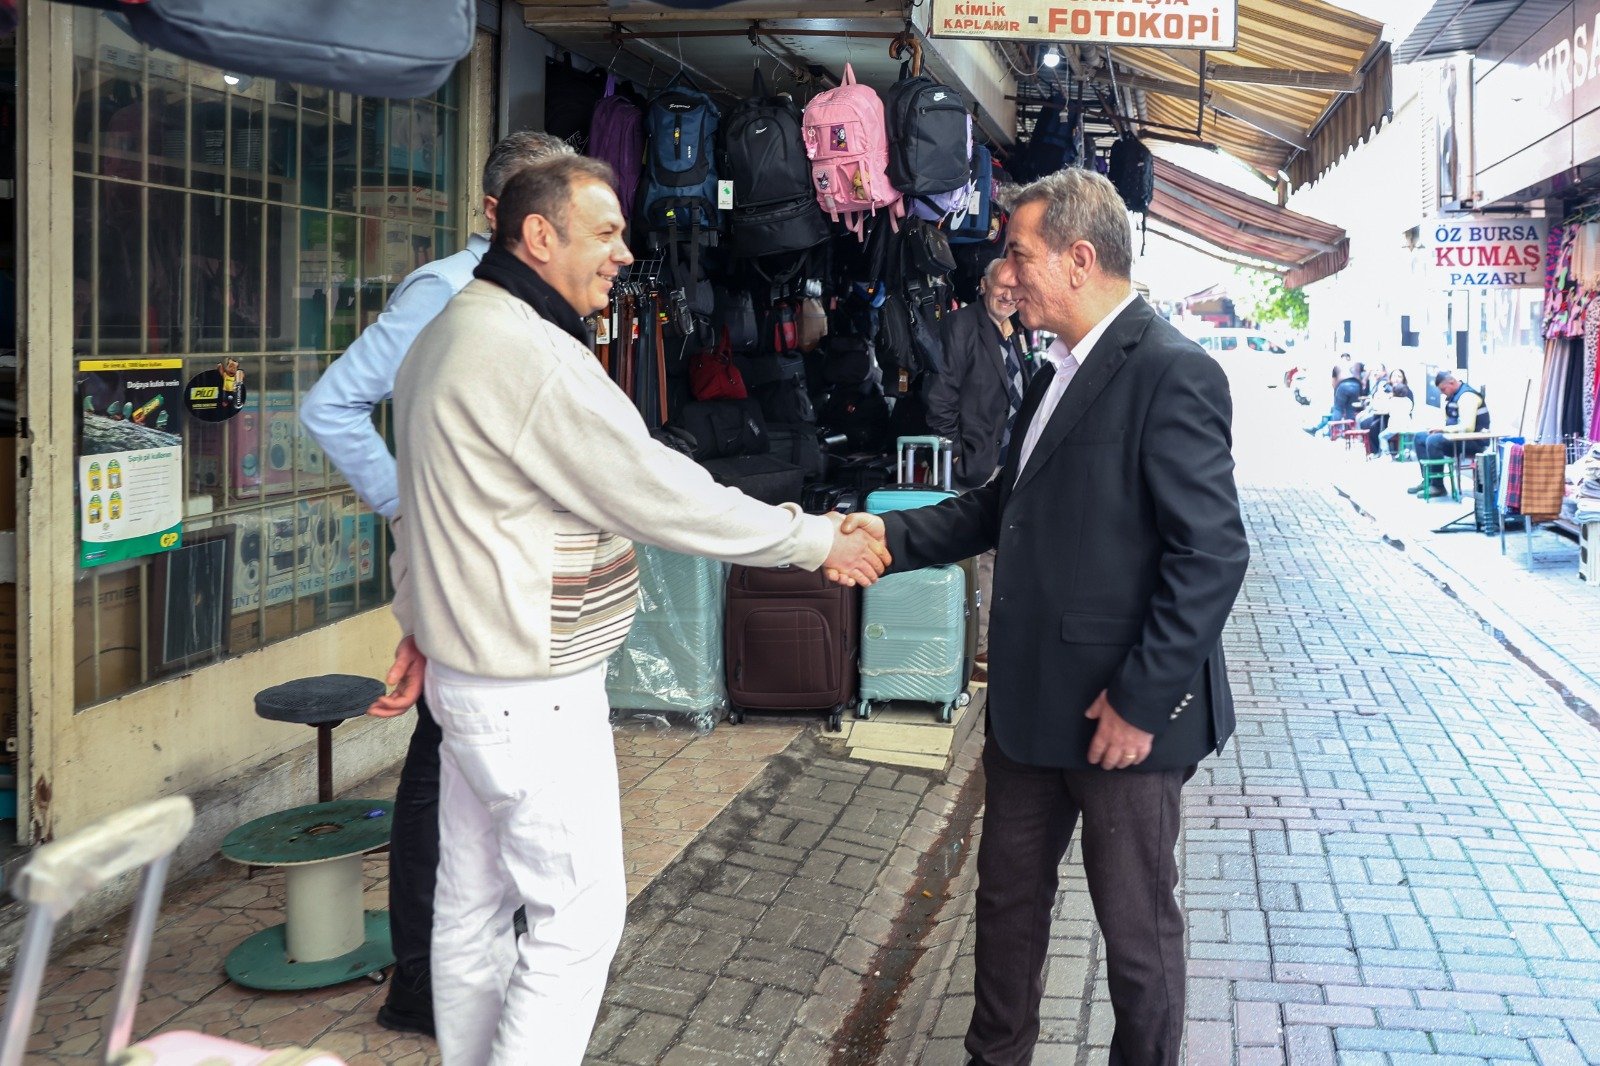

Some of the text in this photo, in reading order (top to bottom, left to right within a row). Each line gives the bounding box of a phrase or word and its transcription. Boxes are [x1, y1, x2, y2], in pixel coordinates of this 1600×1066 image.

[954, 1, 1006, 16] KİMLİK
[1048, 7, 1219, 41] FOTOKOPİ
[1435, 224, 1540, 242] ÖZ BURSA
[1435, 244, 1541, 272] KUMAŞ
[1450, 271, 1527, 285] PAZARI
